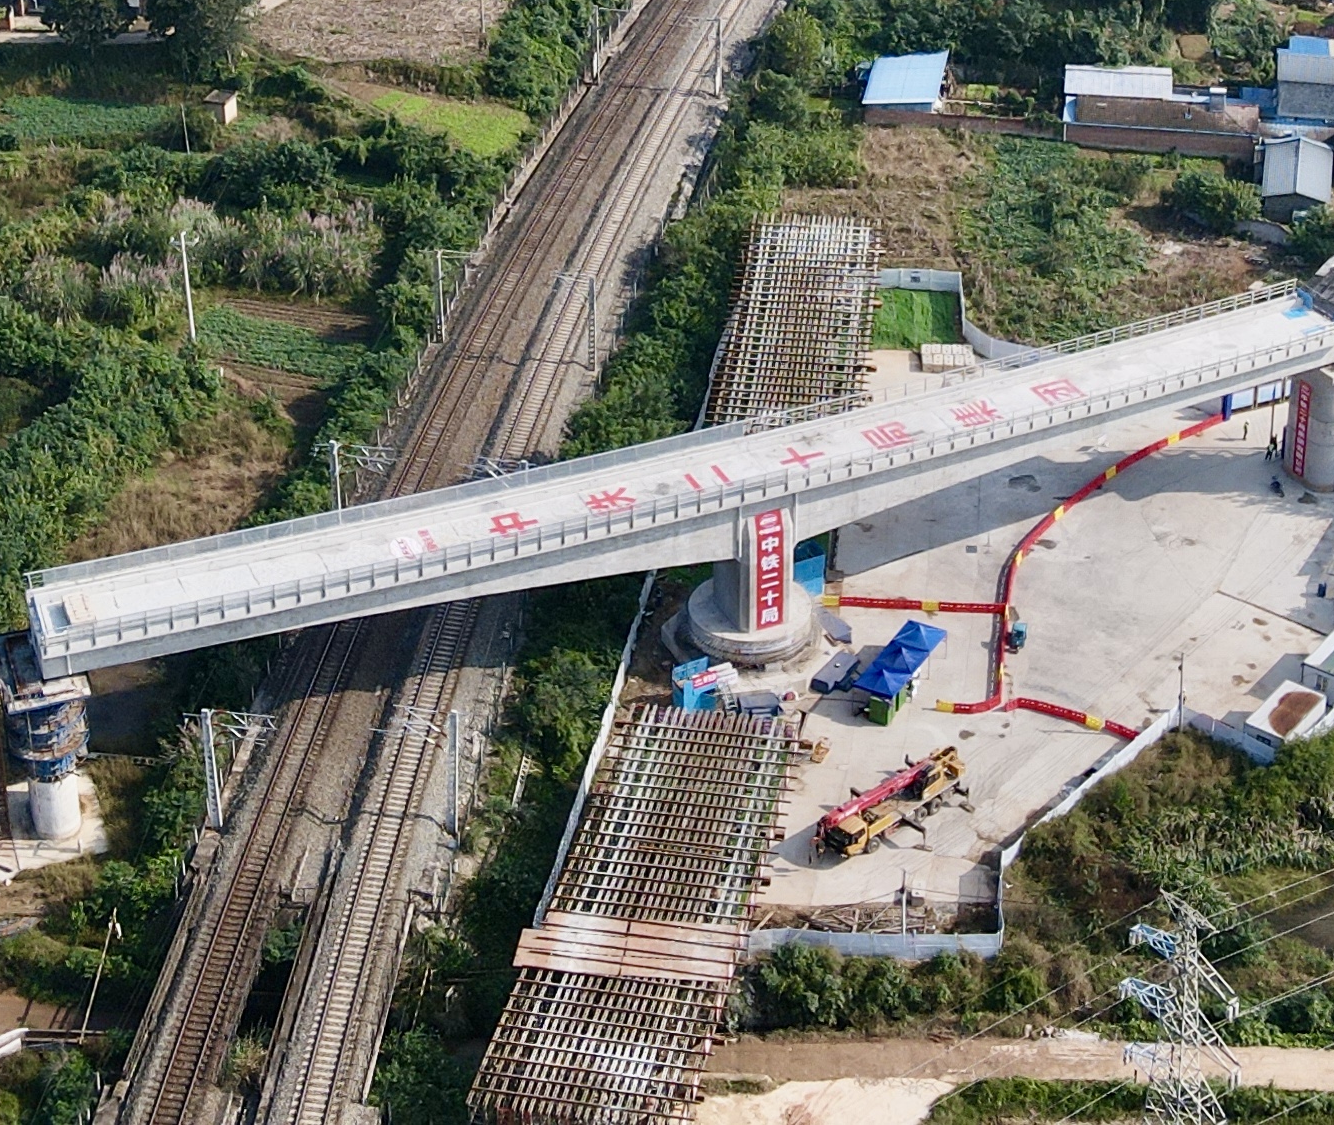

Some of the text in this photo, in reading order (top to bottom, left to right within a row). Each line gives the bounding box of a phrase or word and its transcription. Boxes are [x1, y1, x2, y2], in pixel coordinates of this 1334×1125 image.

[488, 377, 1088, 539] 中铁二十局集团
[760, 536, 780, 625] 中铁二十局
